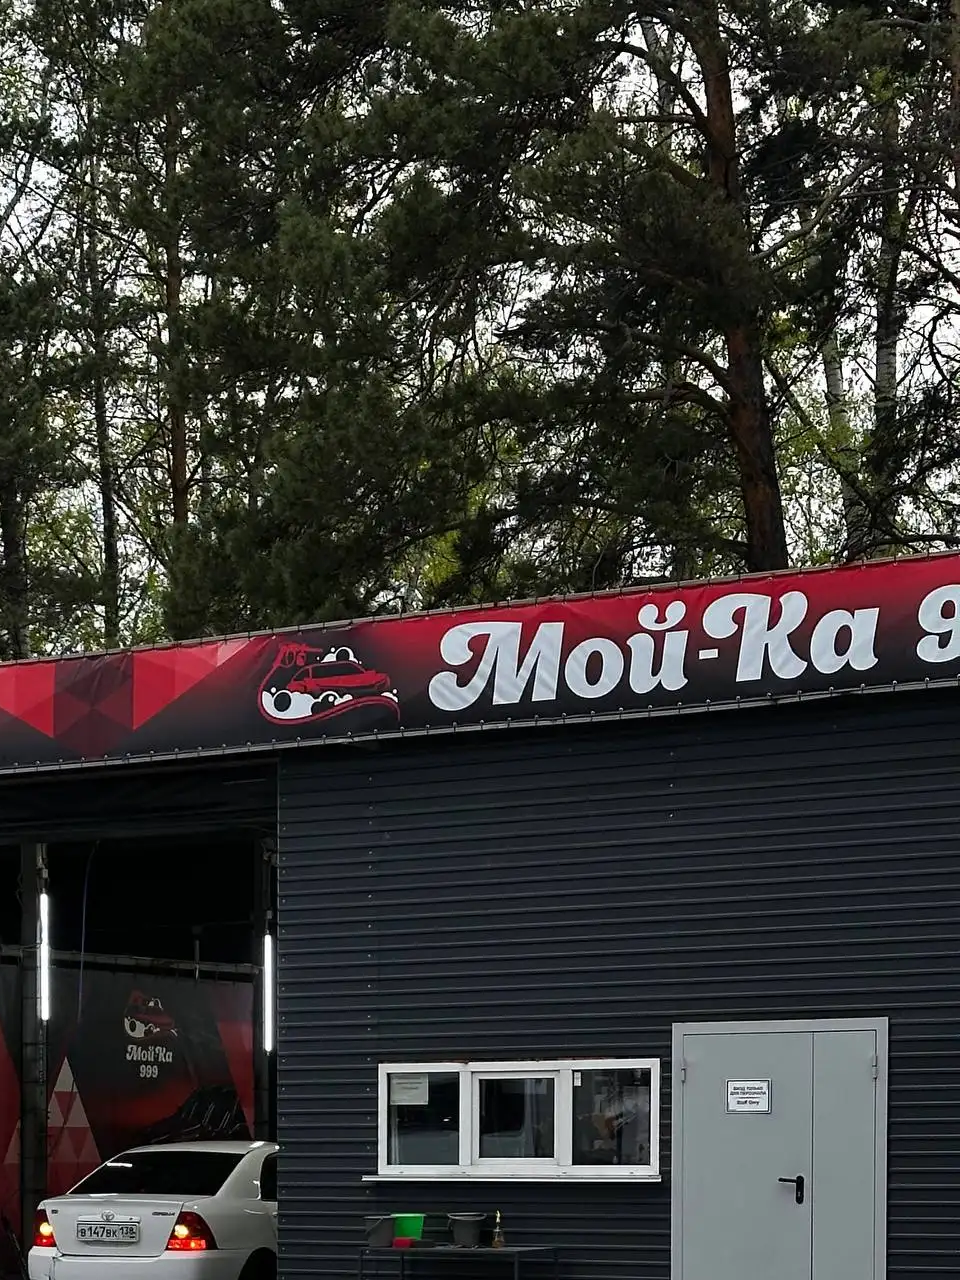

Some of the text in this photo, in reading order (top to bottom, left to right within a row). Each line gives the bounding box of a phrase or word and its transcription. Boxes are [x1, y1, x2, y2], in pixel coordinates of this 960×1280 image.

[428, 584, 960, 712] Мой-Ка 9
[139, 1064, 159, 1079] 999
